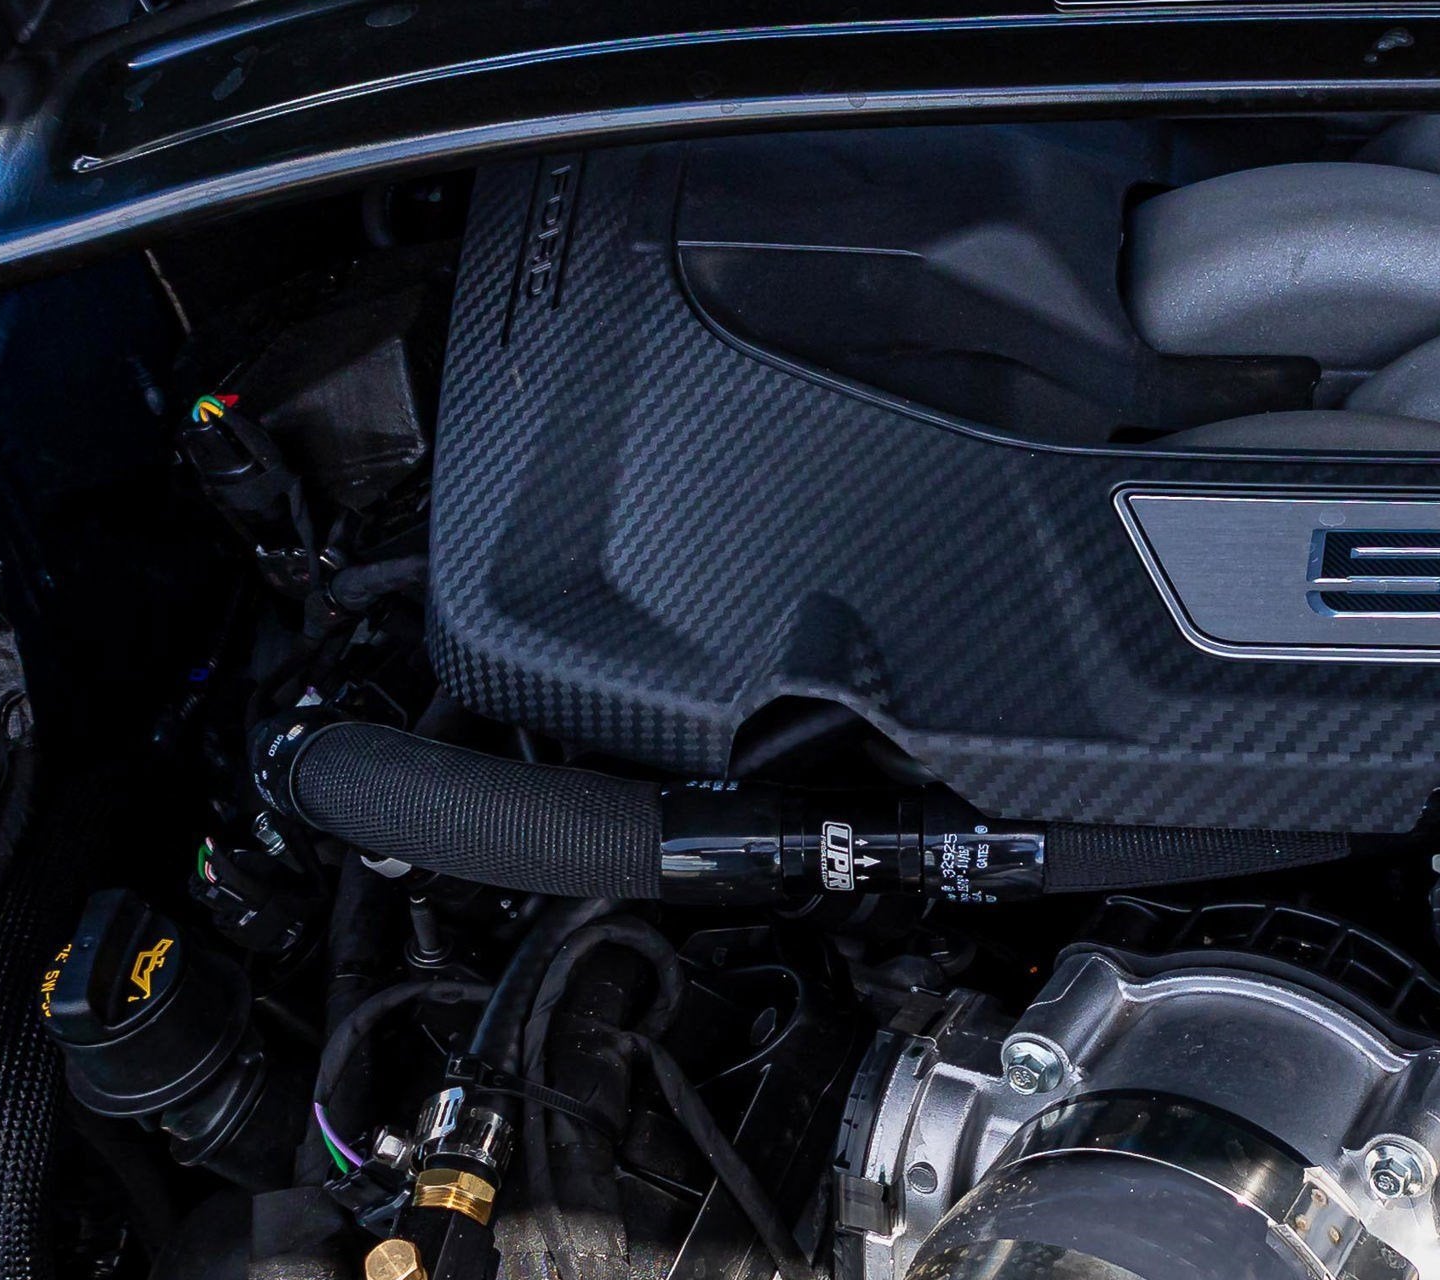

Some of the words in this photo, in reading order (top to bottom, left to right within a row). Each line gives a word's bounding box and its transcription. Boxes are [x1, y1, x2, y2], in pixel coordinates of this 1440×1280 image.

[527, 165, 571, 300] FORD
[826, 823, 852, 889] UPR
[941, 833, 958, 878] 32925
[976, 844, 989, 869] GATES
